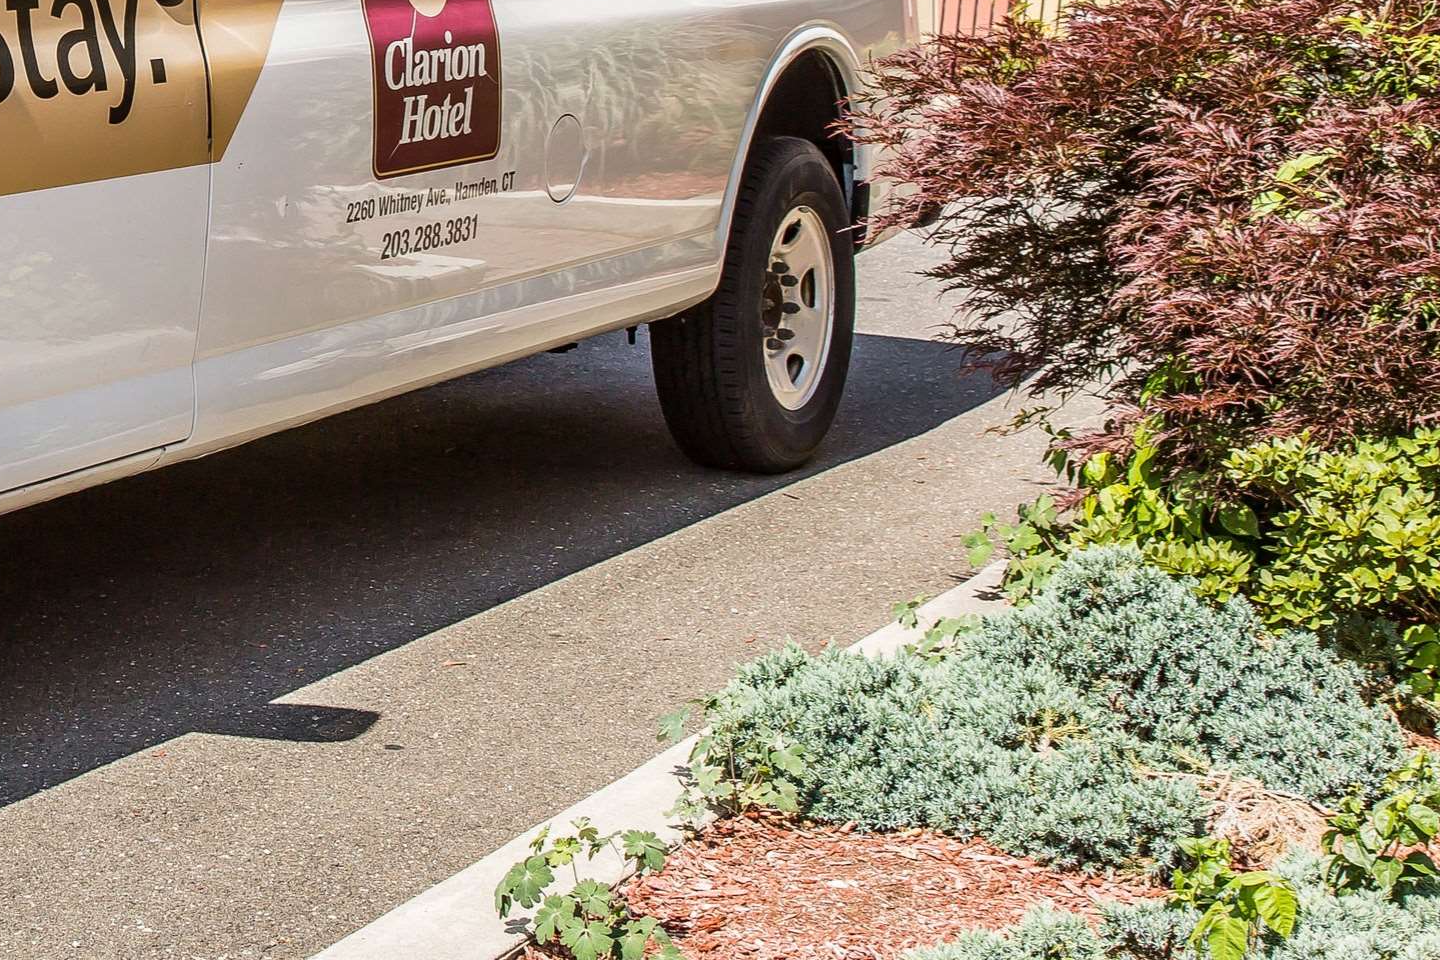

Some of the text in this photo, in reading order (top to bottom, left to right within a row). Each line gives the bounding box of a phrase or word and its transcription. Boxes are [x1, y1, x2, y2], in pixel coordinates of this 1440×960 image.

[385, 10, 488, 90] Clarion
[398, 87, 473, 145] Hotel
[346, 199, 376, 224] 2260
[378, 192, 424, 217] Whitney
[501, 171, 517, 192] CT
[380, 214, 479, 261] 203.288.3831
